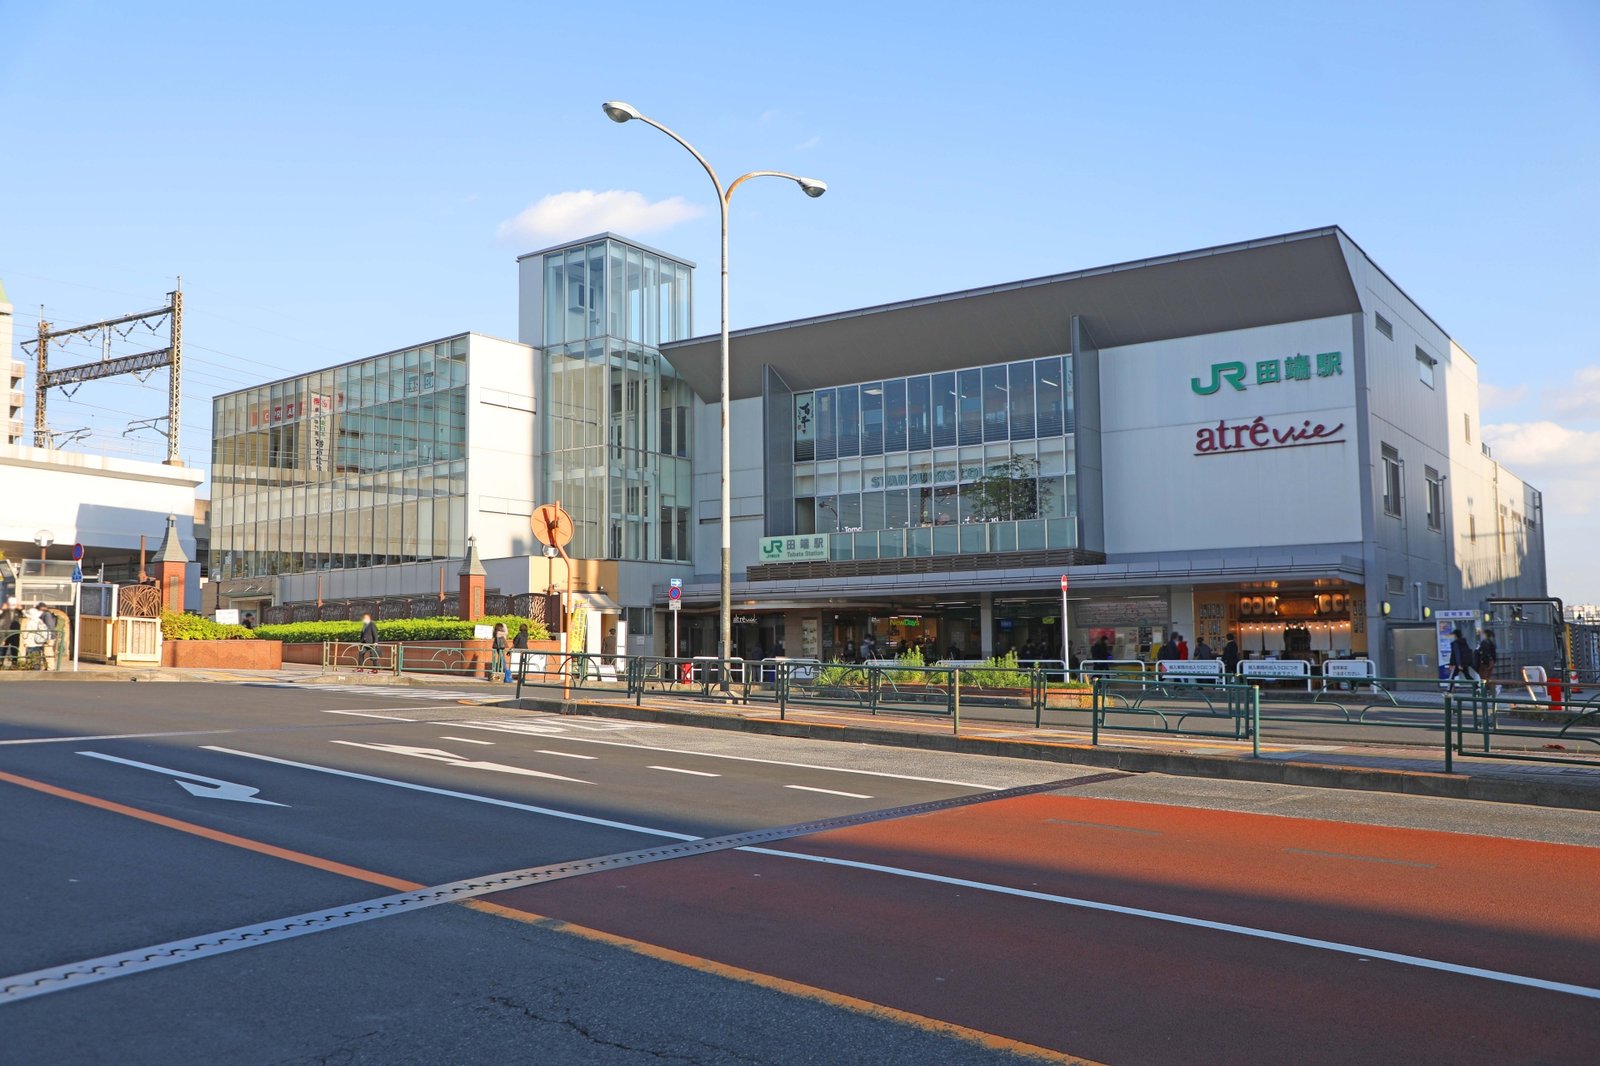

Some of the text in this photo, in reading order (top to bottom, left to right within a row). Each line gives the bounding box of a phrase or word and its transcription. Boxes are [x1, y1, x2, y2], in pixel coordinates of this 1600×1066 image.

[1191, 351, 1343, 396] JR 田端駅
[763, 537, 823, 553] JR 田端駅
